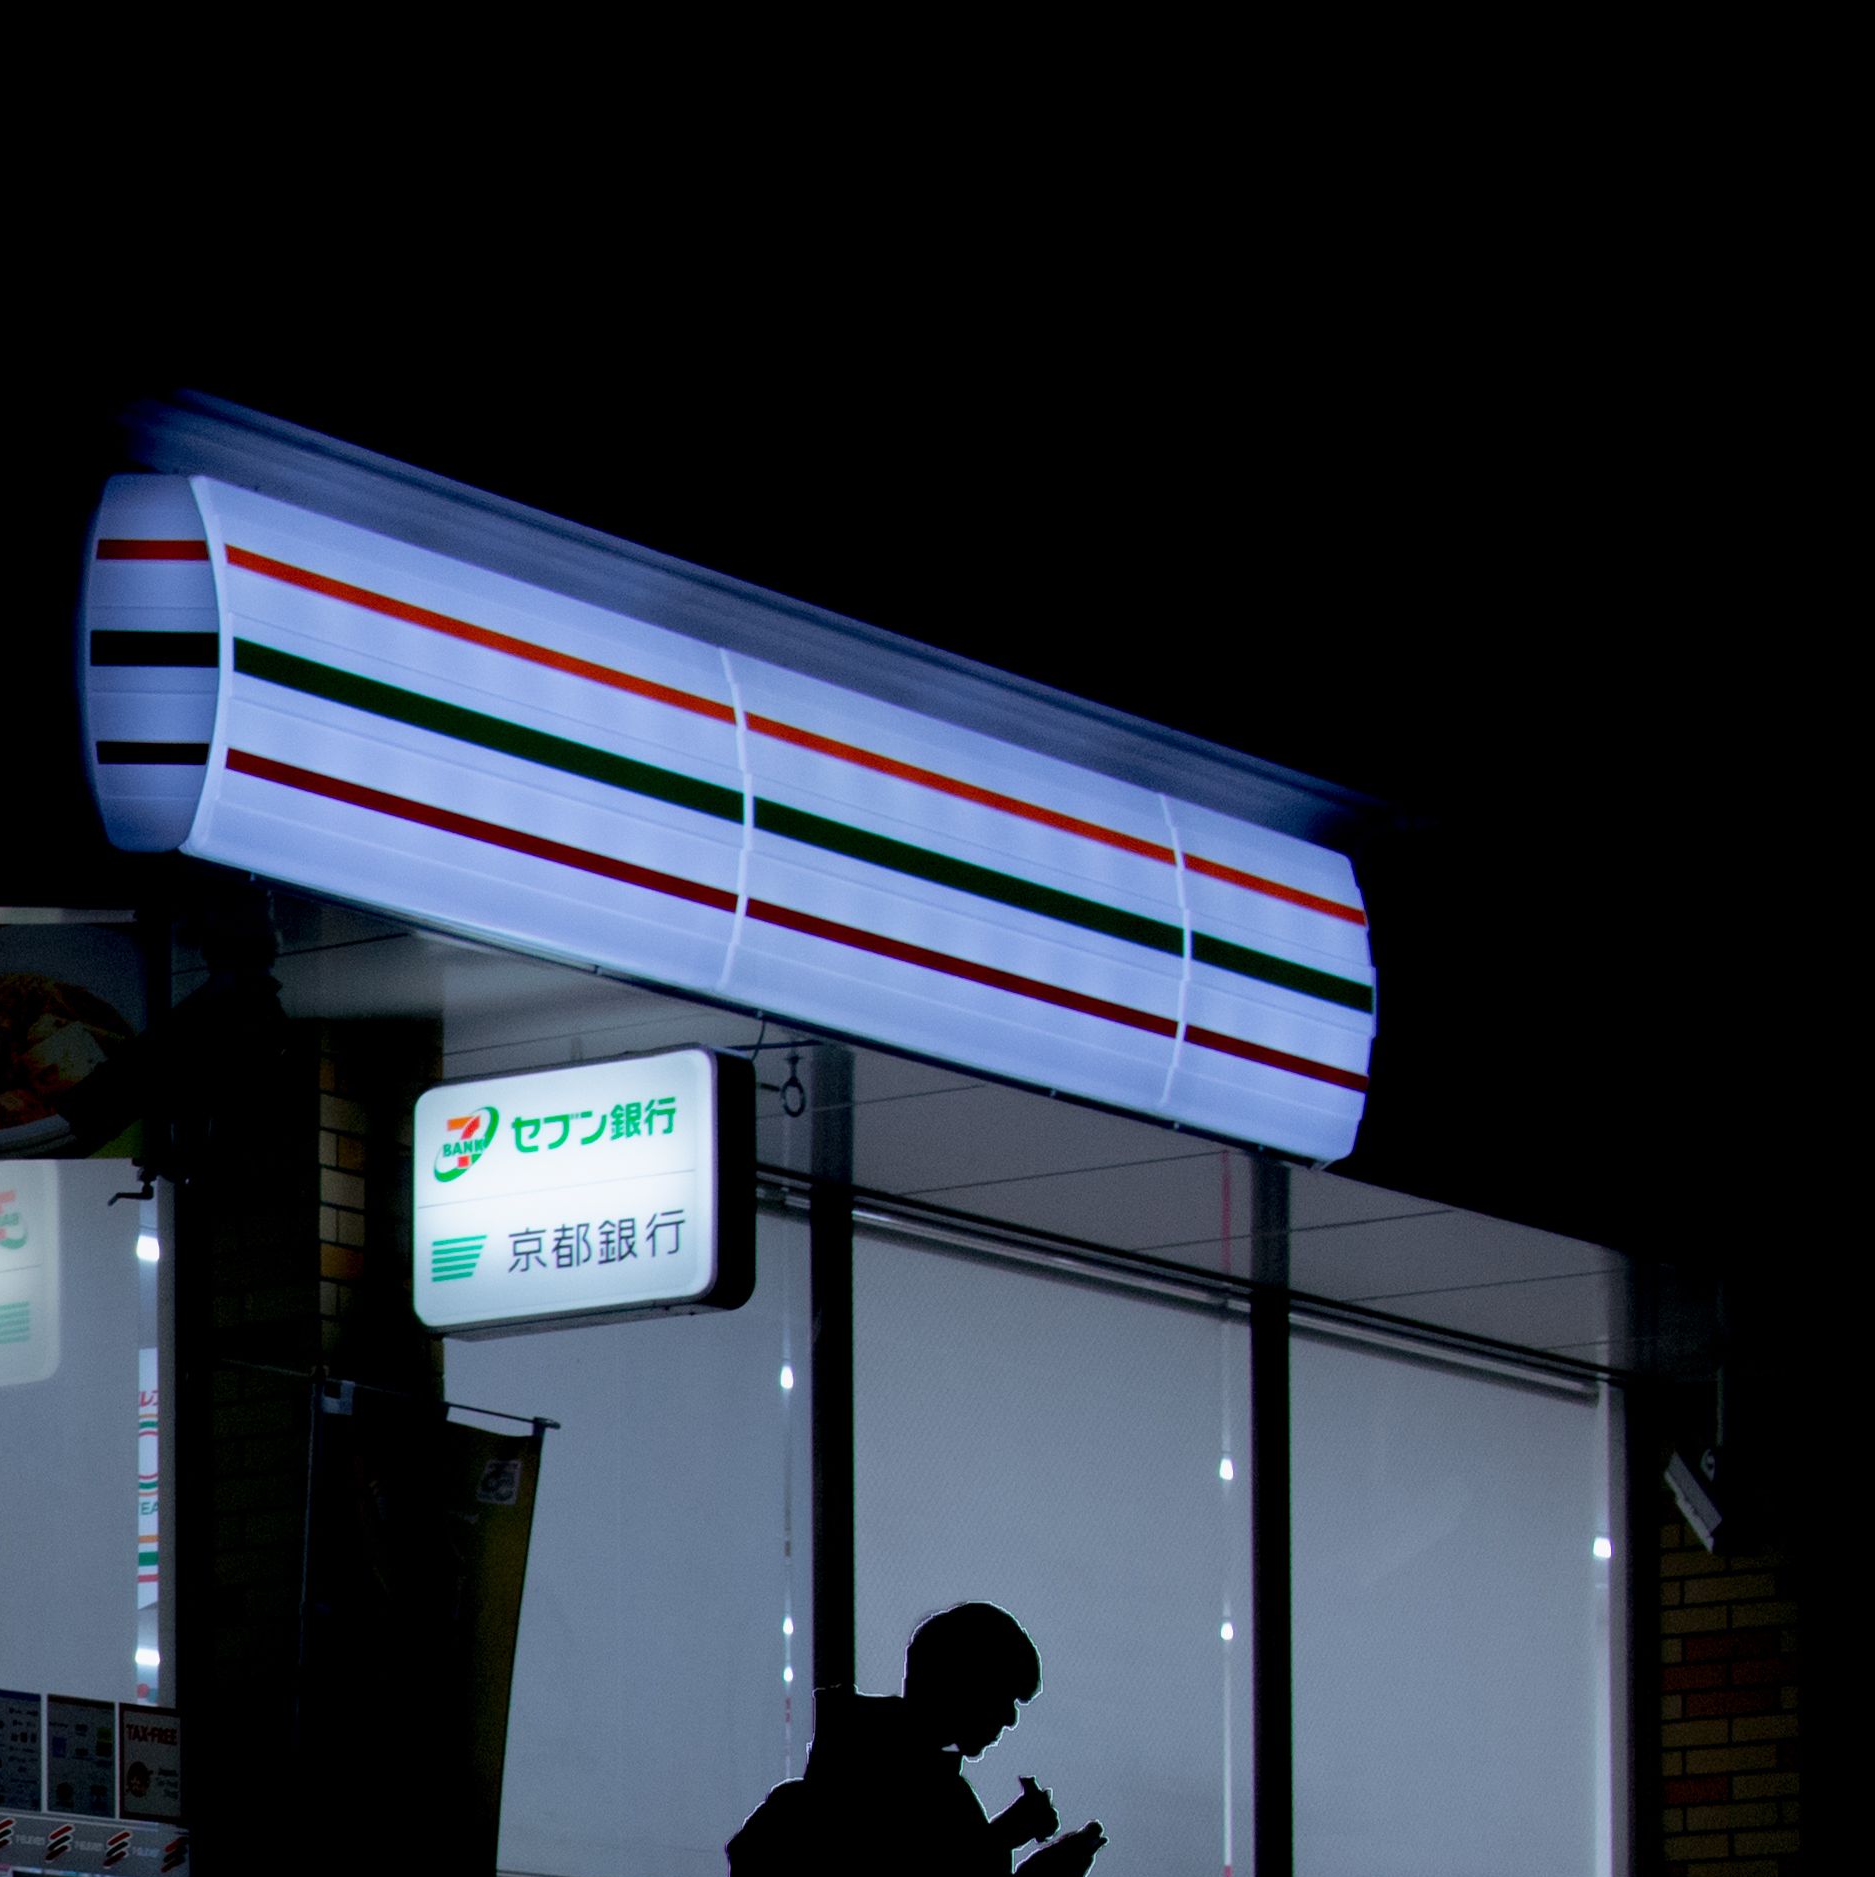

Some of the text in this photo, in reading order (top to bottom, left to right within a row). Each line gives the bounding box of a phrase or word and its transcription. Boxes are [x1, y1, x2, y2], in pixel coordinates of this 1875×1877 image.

[442, 1133, 486, 1158] BANK
[511, 1096, 677, 1154] セブン銀行
[508, 1208, 686, 1274] 京都銀行
[126, 1723, 178, 1746] TAX-FREE
